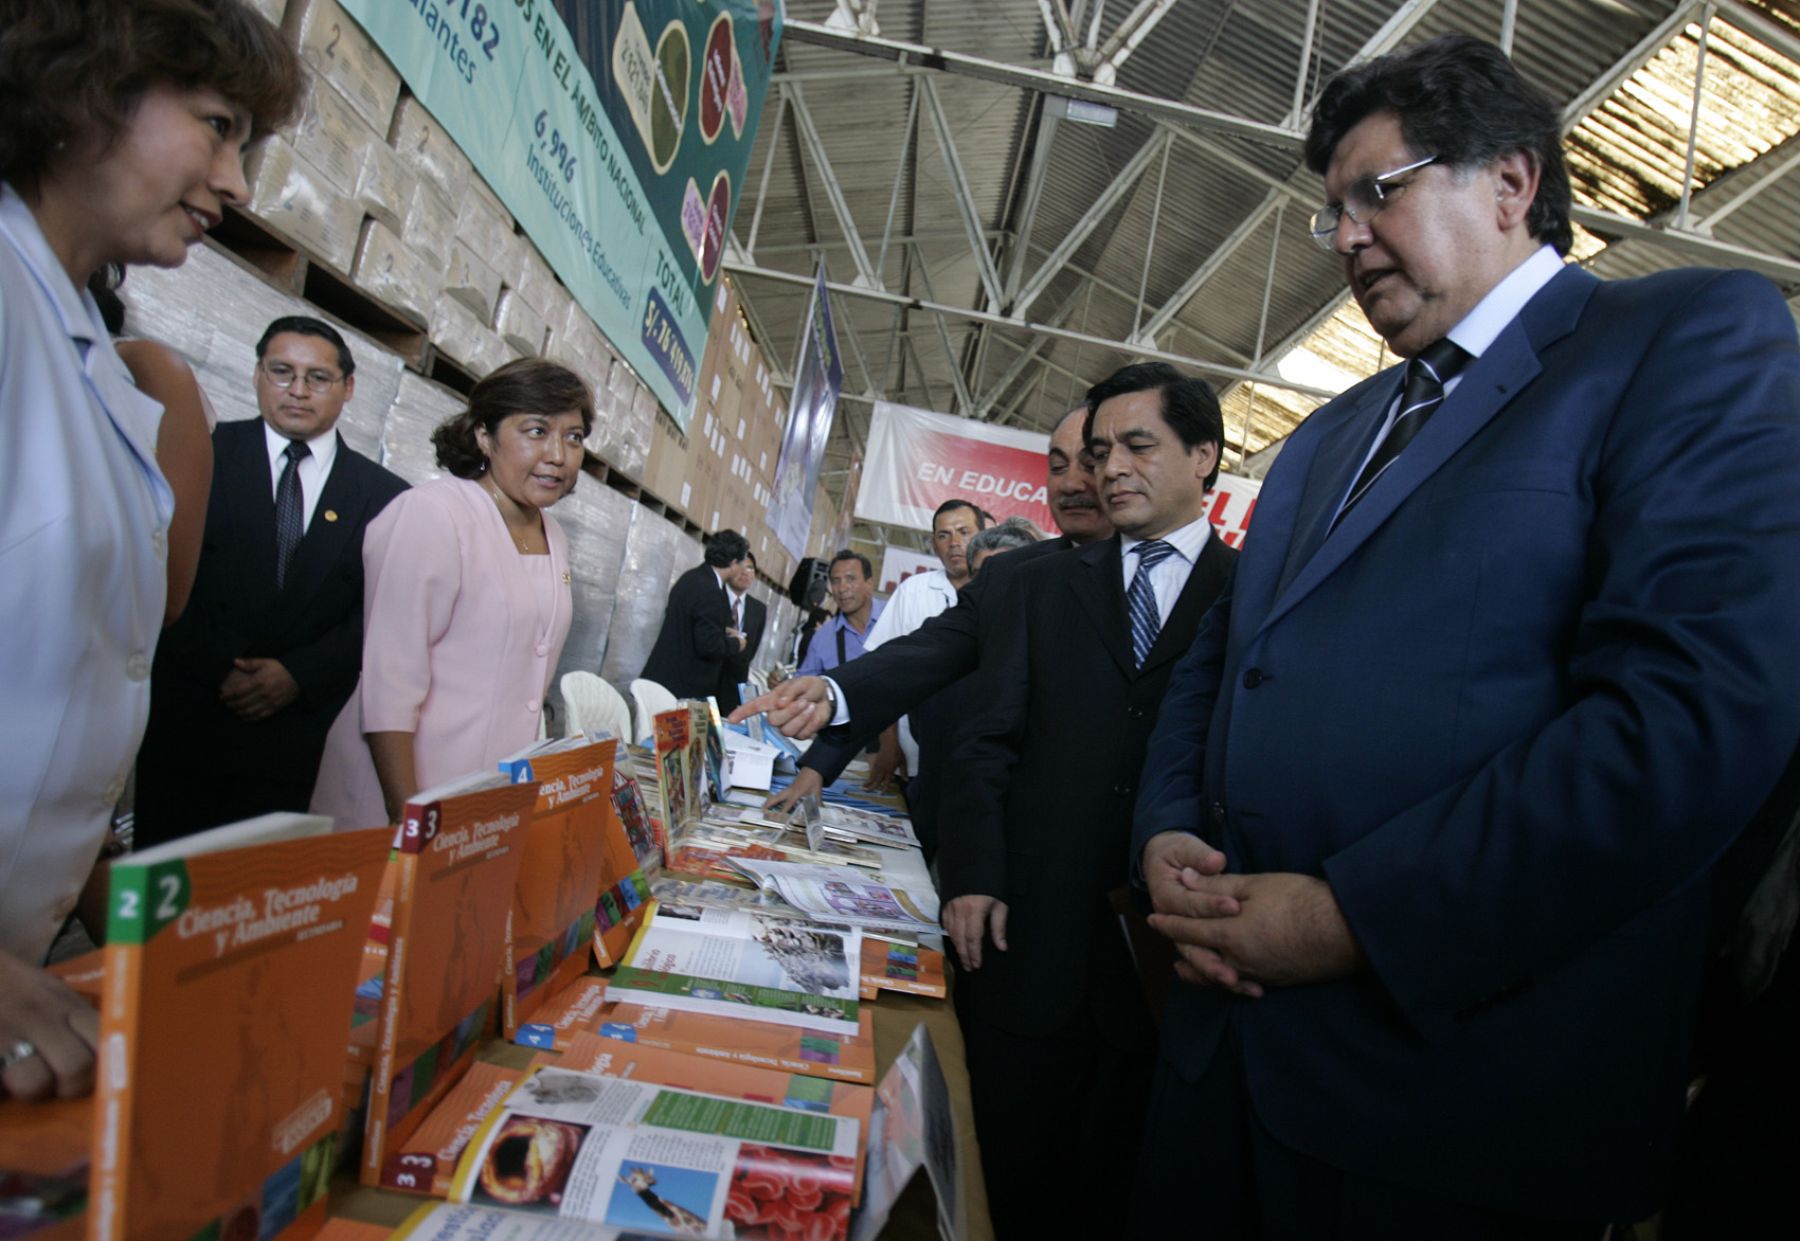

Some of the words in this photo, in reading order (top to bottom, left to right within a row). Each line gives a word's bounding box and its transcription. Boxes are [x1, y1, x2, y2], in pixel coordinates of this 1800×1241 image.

[326, 23, 341, 58] 2
[534, 13, 555, 60] EN
[553, 50, 572, 91] EL
[607, 154, 647, 236] NACIONAL
[534, 109, 577, 183] 6,996
[527, 144, 593, 253] Instituciones
[655, 249, 685, 318] TOTAL
[917, 461, 954, 486] EN
[518, 767, 528, 783] 4
[406, 818, 419, 837] 3
[425, 810, 437, 838] 3
[118, 890, 139, 919] 2
[157, 875, 181, 920] 2
[265, 873, 359, 916] Tecnología
[215, 930, 227, 958] y
[232, 904, 320, 946] Ambiente
[401, 1155, 433, 1168] 3
[397, 1173, 416, 1188] 3
